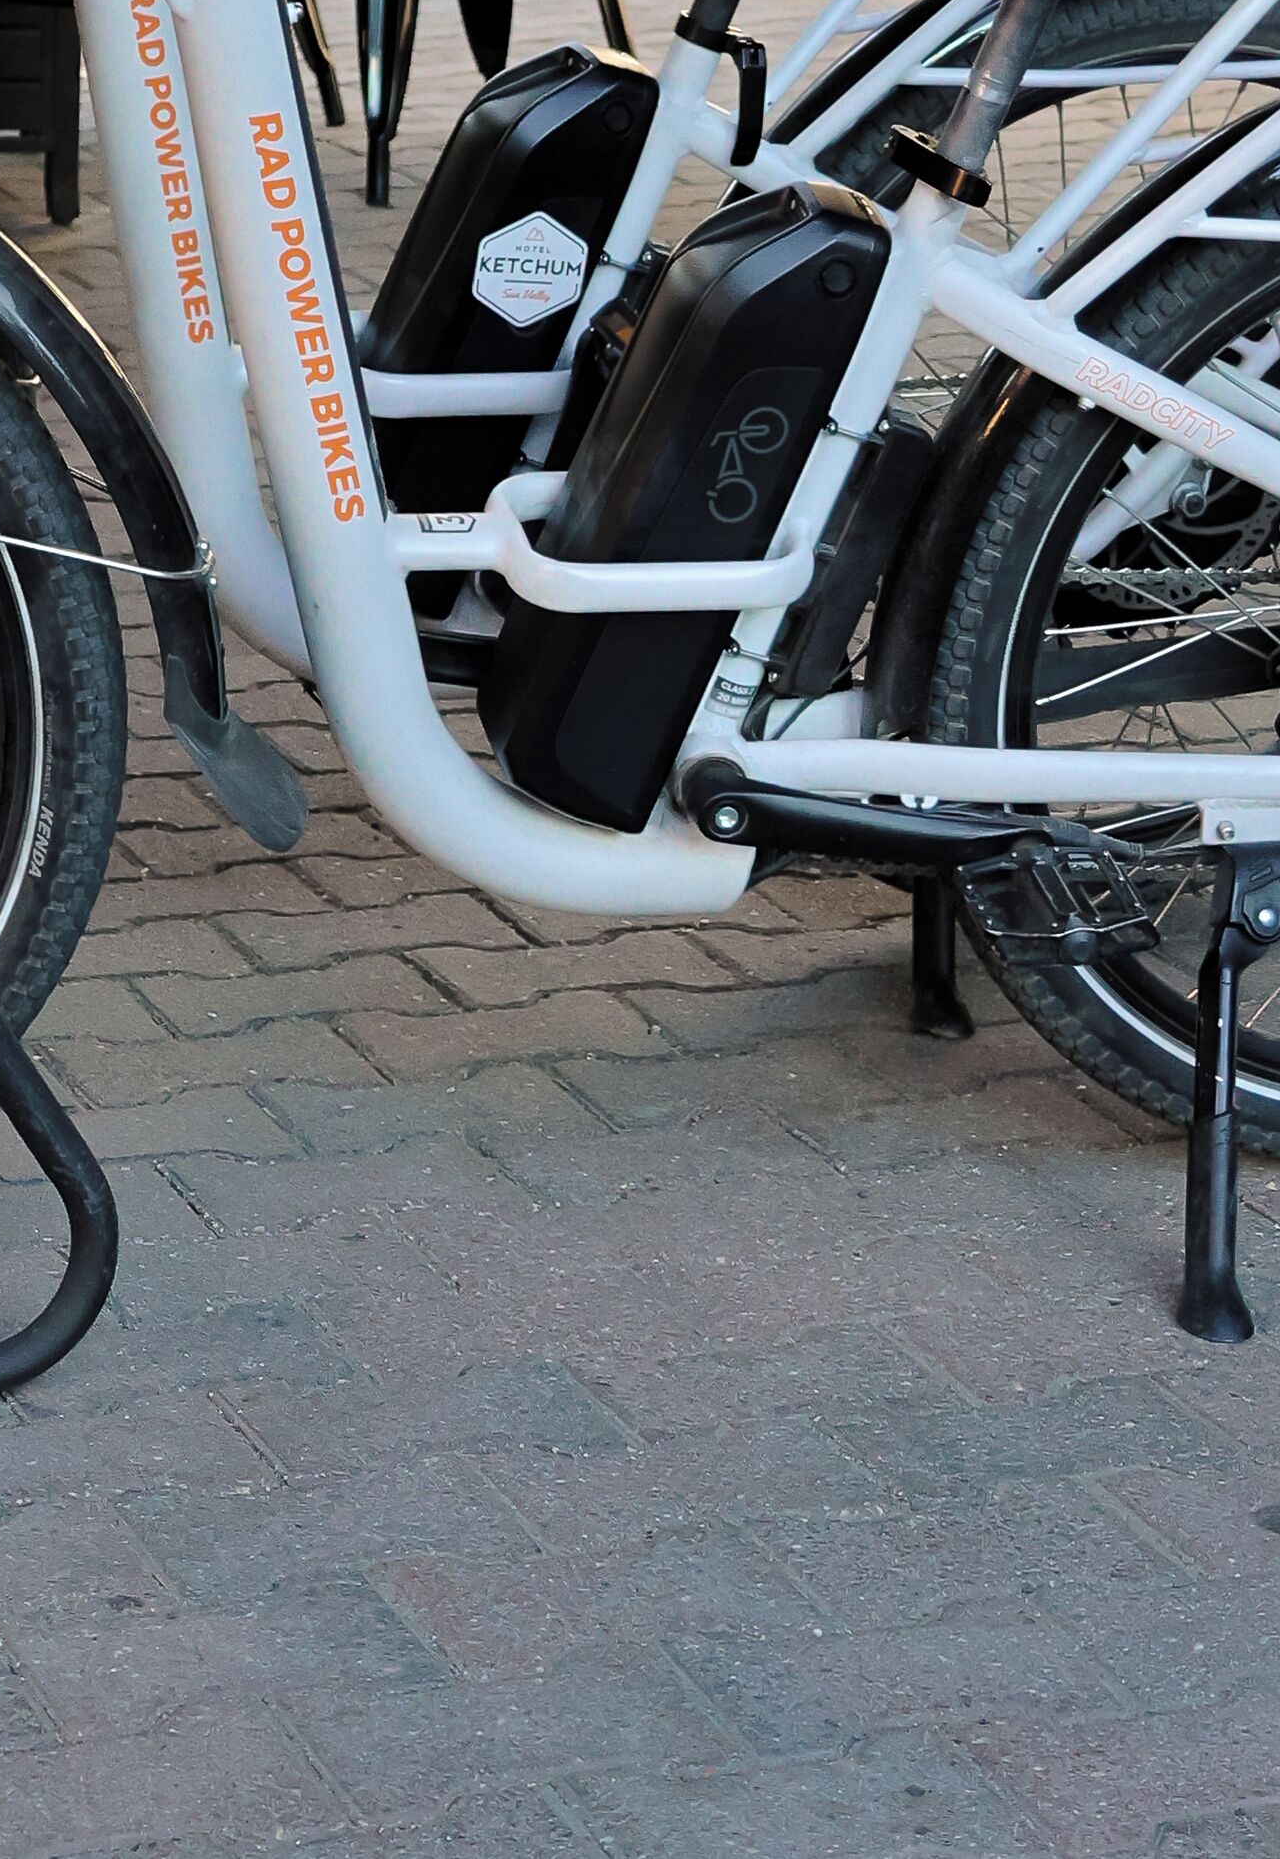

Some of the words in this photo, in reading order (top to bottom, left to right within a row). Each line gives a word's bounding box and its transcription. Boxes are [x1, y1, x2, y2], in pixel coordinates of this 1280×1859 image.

[248, 112, 297, 209] RAD
[144, 74, 193, 222] POWER
[171, 228, 215, 344] BIKES
[515, 245, 551, 254] HOTEL
[271, 218, 336, 386] POWER
[479, 256, 581, 277] KETCHUM
[501, 288, 520, 299] Sun
[522, 288, 551, 303] Valley
[1075, 356, 1235, 450] RADCITY
[310, 392, 365, 522] BIKES
[29, 805, 54, 878] KENDA
